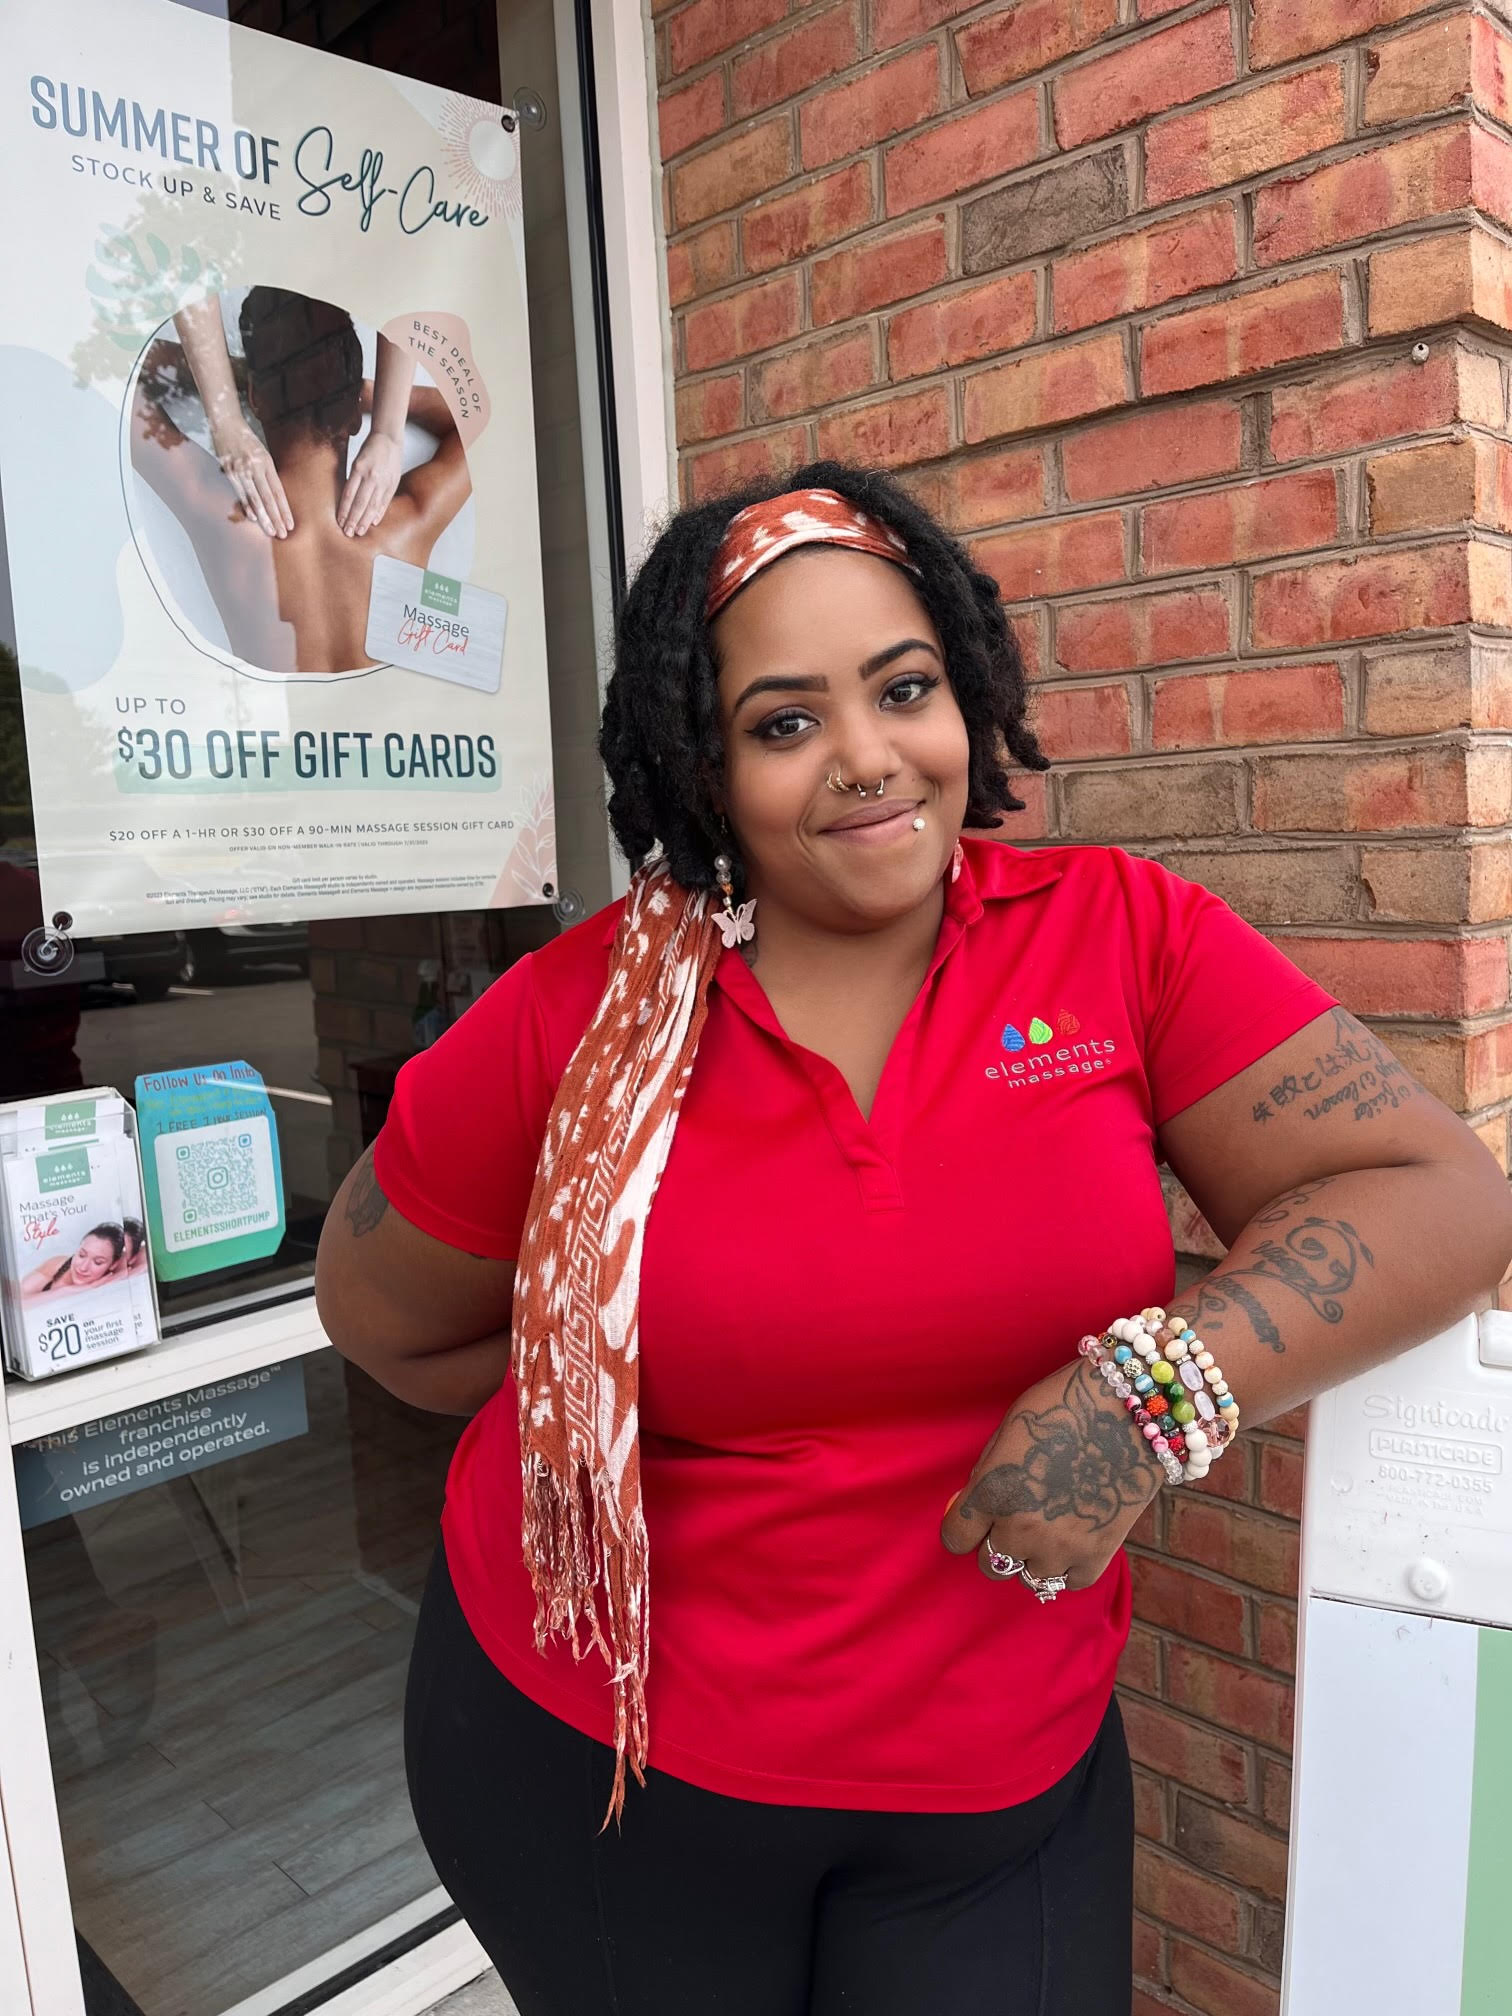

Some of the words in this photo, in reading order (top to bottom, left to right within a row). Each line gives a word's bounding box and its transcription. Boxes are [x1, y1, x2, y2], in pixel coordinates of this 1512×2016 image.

[30, 75, 222, 172] SUMMER
[233, 129, 279, 184] OF
[295, 126, 489, 234] Self-Care
[71, 154, 153, 189] STOCK
[163, 175, 193, 197] UP
[203, 186, 216, 204] &
[225, 192, 281, 221] SAVE
[408, 336, 436, 357] THE
[440, 358, 470, 419] SEASON
[413, 320, 448, 345] BEST
[450, 347, 475, 387] DEAL
[471, 393, 482, 413] OF
[397, 618, 434, 652] Gift
[432, 630, 469, 656] Card
[403, 604, 470, 638] Massage
[115, 697, 147, 714] UP
[155, 698, 186, 715] TO
[117, 726, 192, 780] $30
[206, 729, 280, 780] OFF
[294, 731, 373, 779] GIFT
[384, 732, 497, 779] CARDS
[109, 830, 135, 841] $20
[140, 829, 168, 840] OFF
[172, 830, 181, 839] A
[186, 828, 216, 838] 1-HR
[220, 827, 239, 838] OR
[243, 826, 265, 837] $30
[269, 826, 293, 836] OFF
[297, 826, 305, 835] A
[309, 824, 352, 834] 90-MIN
[356, 822, 410, 833] MASSAGE
[413, 821, 459, 832] SESSION
[462, 821, 484, 831] GIFT
[487, 820, 515, 830] CARD
[985, 1039, 1116, 1079] elements
[143, 1075, 189, 1092] Follow
[168, 1119, 197, 1132] FREE
[19, 1194, 75, 1213] Massage
[20, 1207, 59, 1225] That's
[60, 1203, 87, 1217] Your
[23, 1216, 60, 1250] Style
[173, 1211, 271, 1243] ELEMENTSSHORTPUMP
[46, 1313, 75, 1328] SAVE
[84, 1324, 104, 1336] your
[105, 1319, 123, 1329] first
[85, 1326, 124, 1343] massage
[38, 1323, 82, 1361] $20
[83, 1320, 95, 1328] on
[86, 1335, 119, 1350] session
[84, 1398, 183, 1438] Elements
[119, 1406, 212, 1445] franchise
[83, 1461, 99, 1476] is
[105, 1411, 248, 1470] independently
[1377, 1436, 1495, 1466] PLASTICADE
[60, 1465, 131, 1502] owned
[136, 1452, 175, 1477] and
[179, 1421, 271, 1462] operated.
[1379, 1464, 1494, 1494] 800-772-0355
